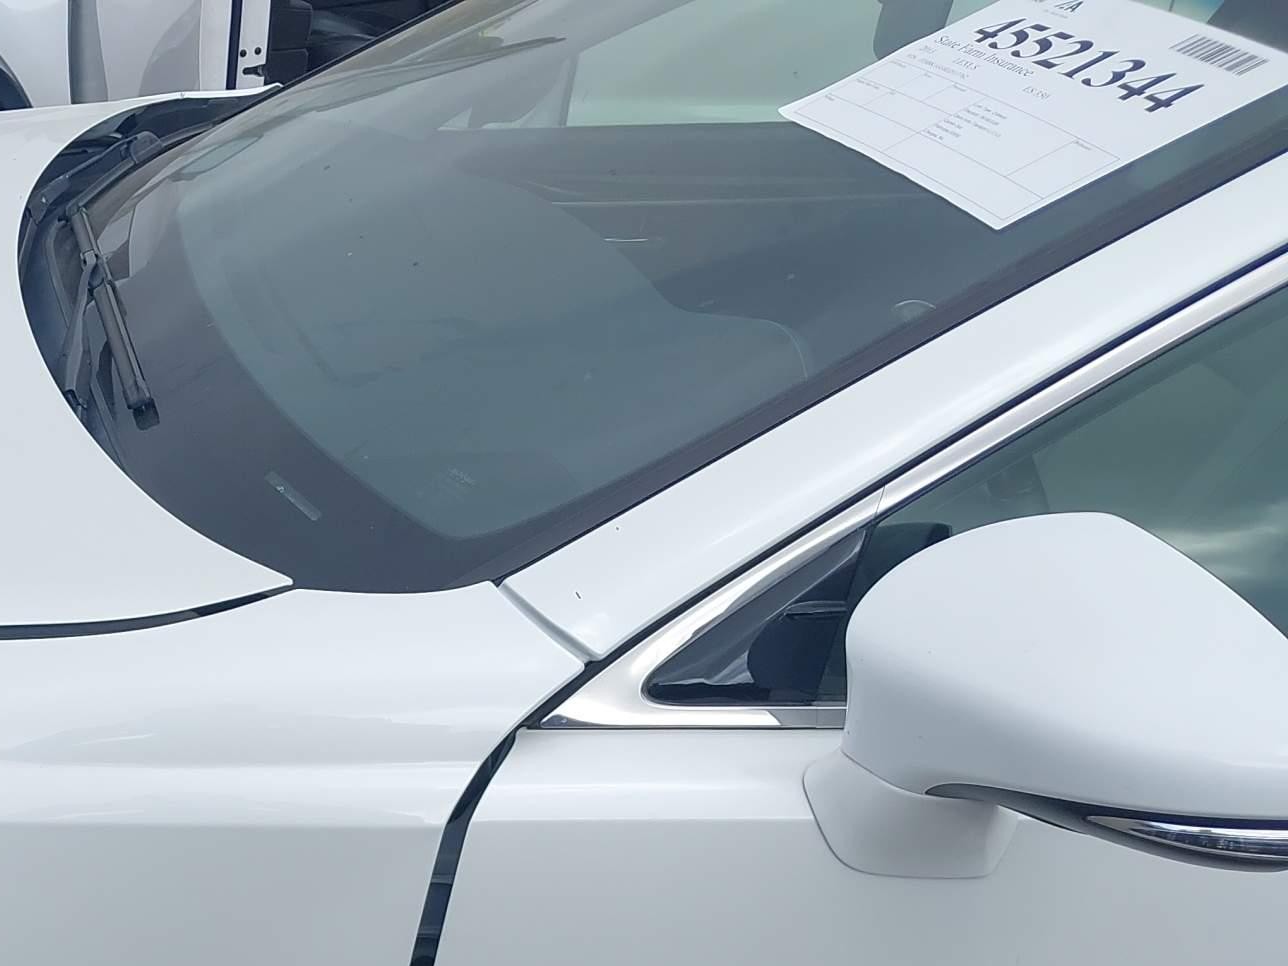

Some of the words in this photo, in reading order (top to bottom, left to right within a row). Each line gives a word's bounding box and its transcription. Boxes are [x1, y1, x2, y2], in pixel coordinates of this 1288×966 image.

[934, 35, 961, 49] State
[958, 43, 987, 59] Farm
[983, 53, 1034, 77] Insurance
[974, 18, 1205, 113] 45521344
